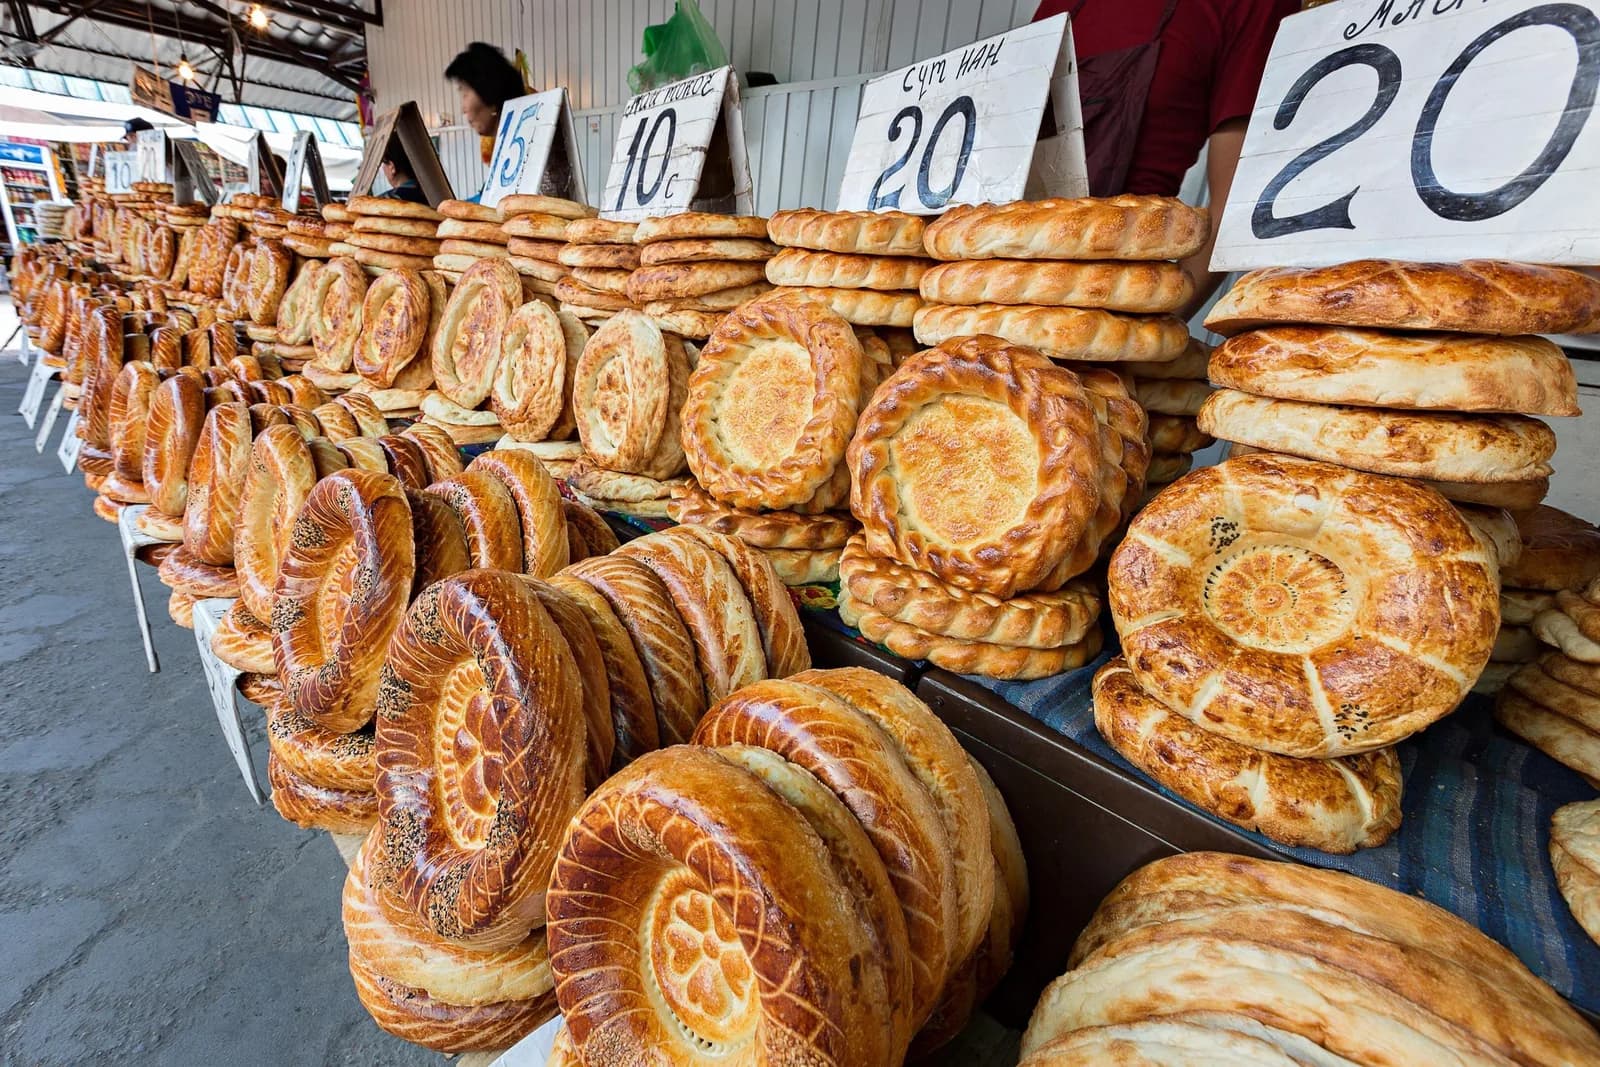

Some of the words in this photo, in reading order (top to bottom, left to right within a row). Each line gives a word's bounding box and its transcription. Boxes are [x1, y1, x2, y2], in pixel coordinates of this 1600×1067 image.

[486, 101, 538, 191] 15
[615, 108, 676, 212] 10
[867, 96, 977, 211] 20
[1251, 3, 1600, 239] 20
[112, 162, 131, 189] 10
